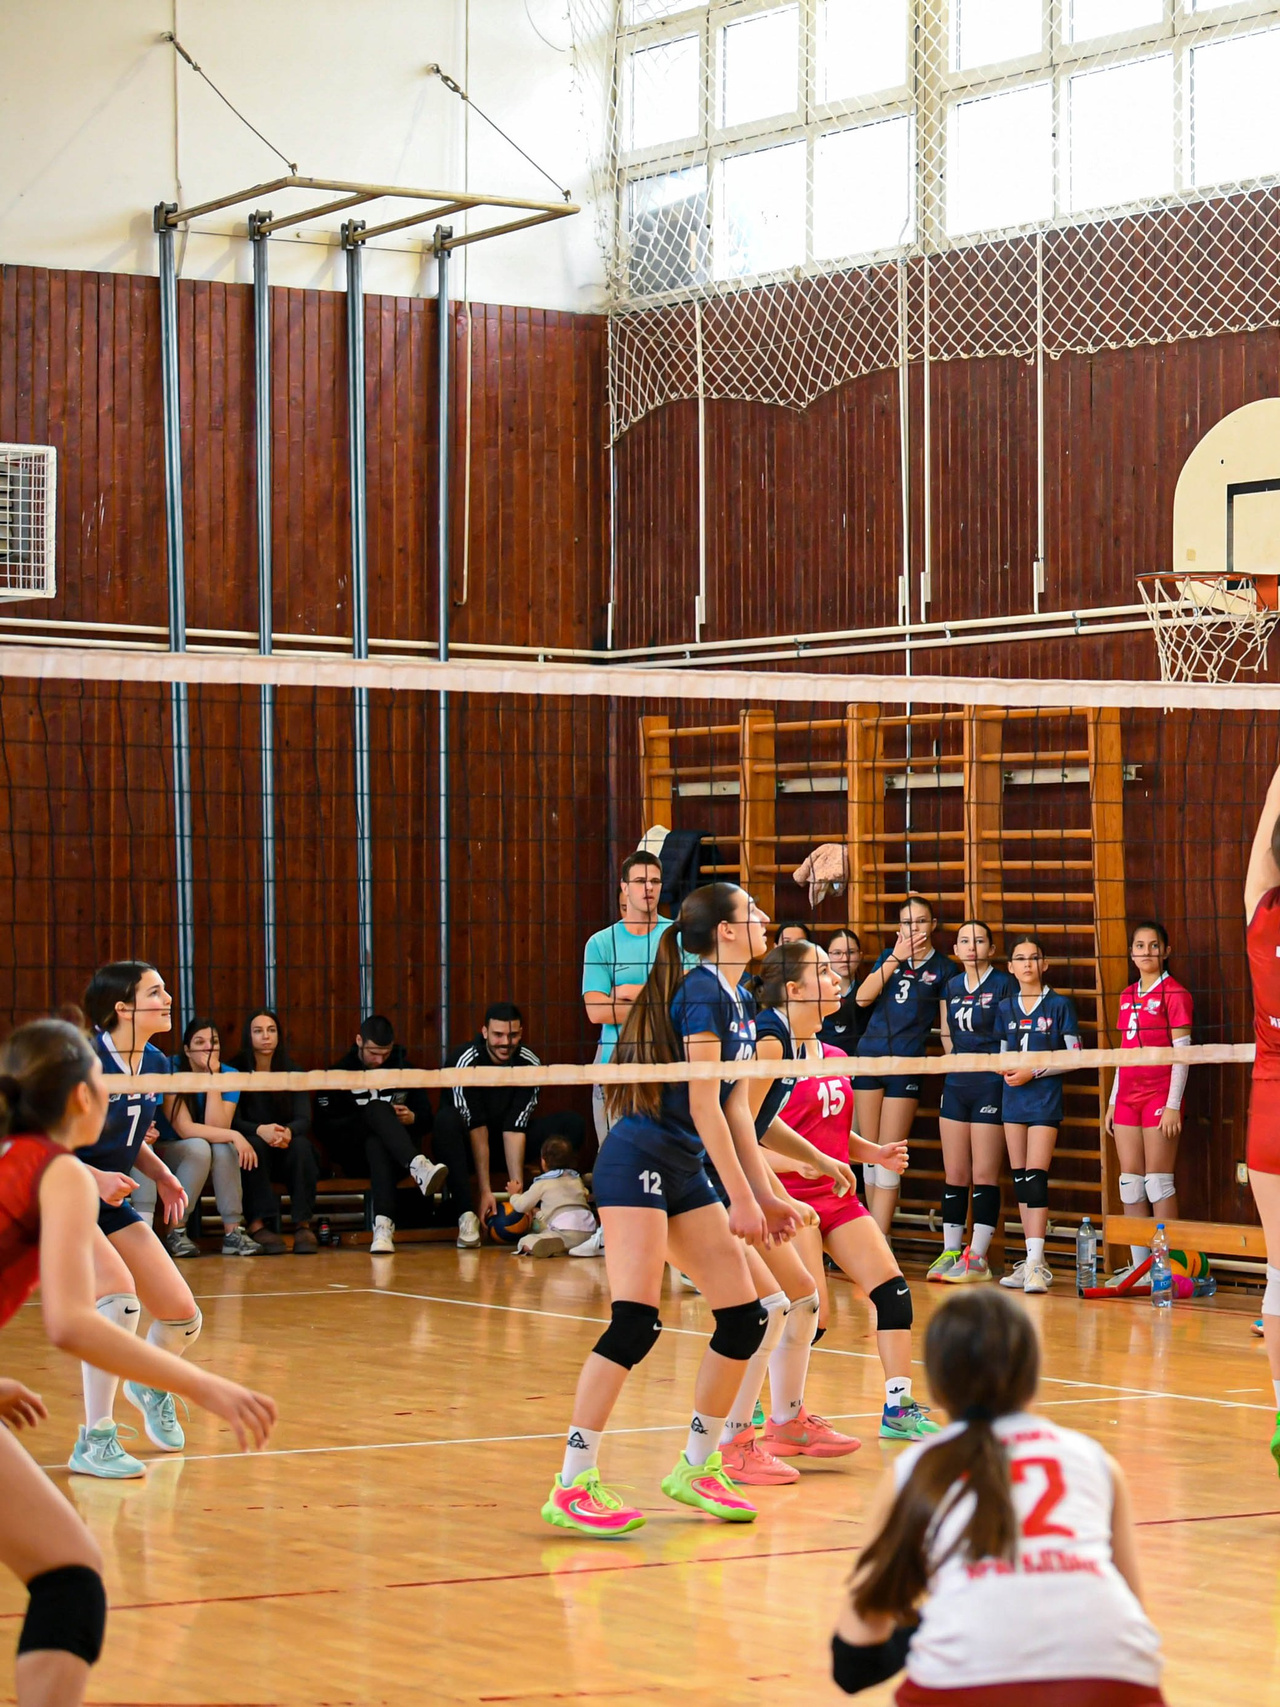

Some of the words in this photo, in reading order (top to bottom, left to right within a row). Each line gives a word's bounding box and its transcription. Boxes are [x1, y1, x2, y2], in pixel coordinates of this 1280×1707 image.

[895, 979, 911, 1004] 3
[954, 1007, 975, 1032] 11
[1126, 1012, 1139, 1040] 5
[817, 1079, 846, 1118] 15
[126, 1105, 141, 1147] 7
[638, 1170, 662, 1195] 12
